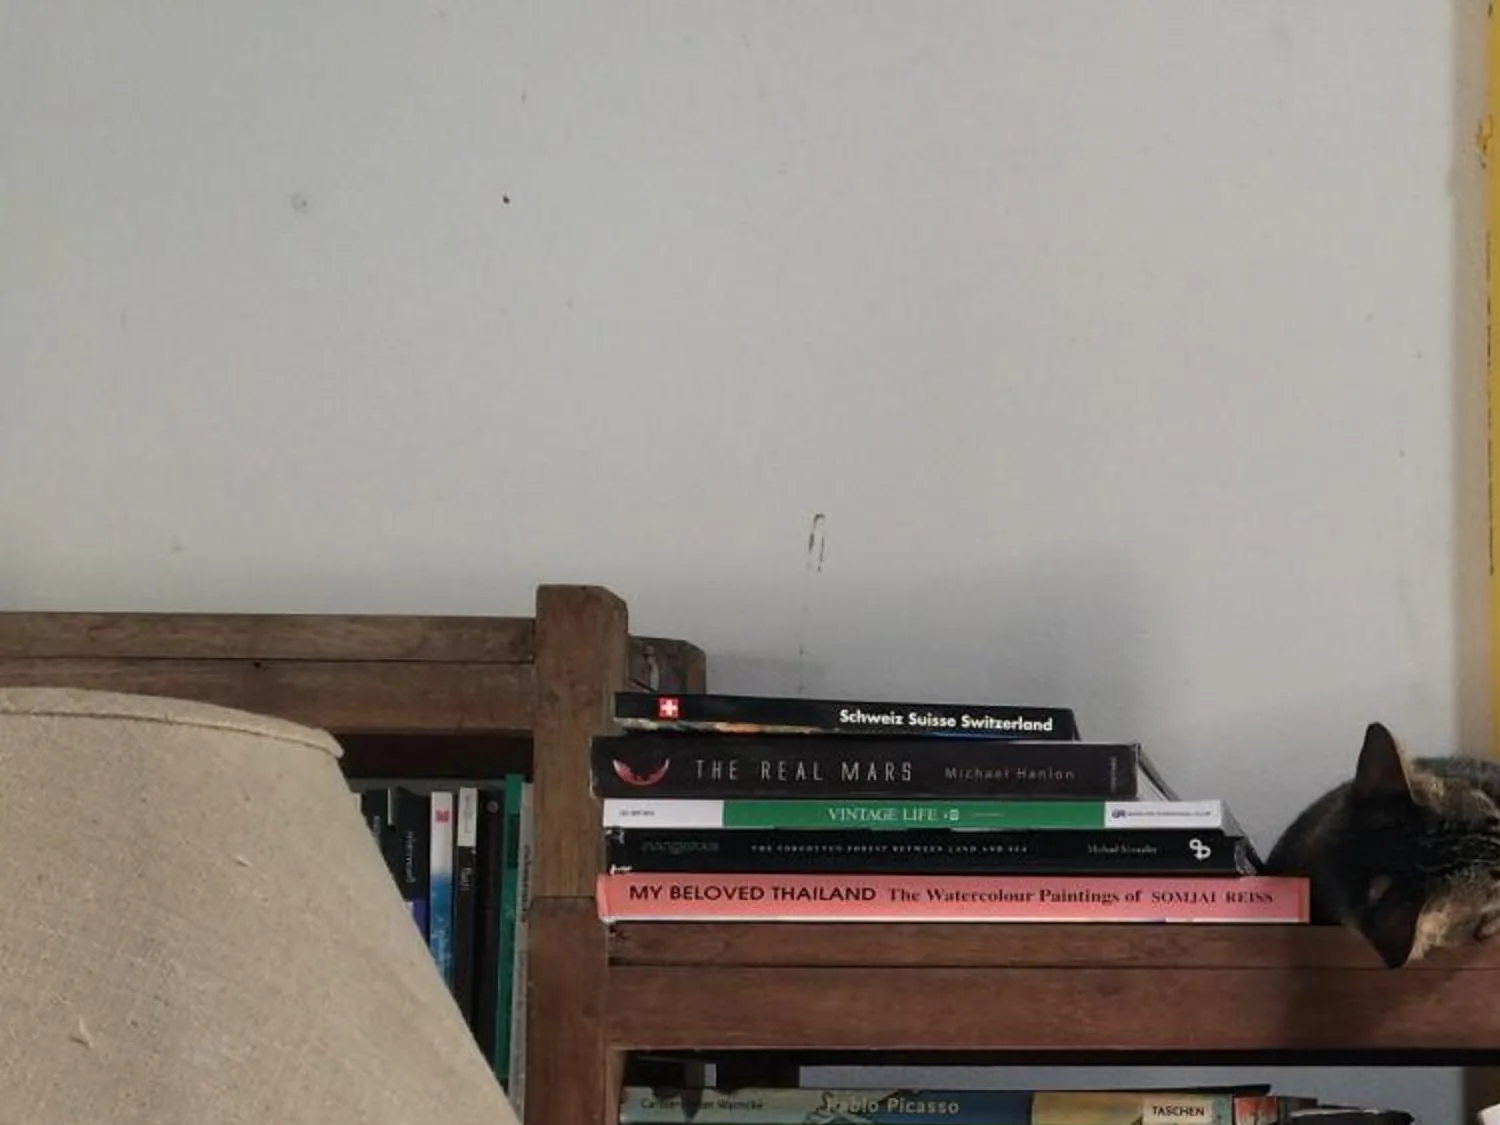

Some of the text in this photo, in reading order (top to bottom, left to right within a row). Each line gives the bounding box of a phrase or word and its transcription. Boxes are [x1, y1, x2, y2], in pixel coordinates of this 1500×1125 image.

[840, 708, 1053, 732] Schweiz Suisse Switzerland
[696, 759, 913, 782] THE REAL MARS
[826, 807, 938, 822] VINTAGE LIFE
[629, 886, 877, 902] MY BELOVED THAILAND
[888, 887, 920, 902] The
[927, 888, 1034, 904] Watercolour
[1039, 889, 1120, 907] Paintings
[1126, 889, 1143, 904] of
[888, 1097, 960, 1114] Picasso
[1153, 1105, 1205, 1117] TASCHEN
